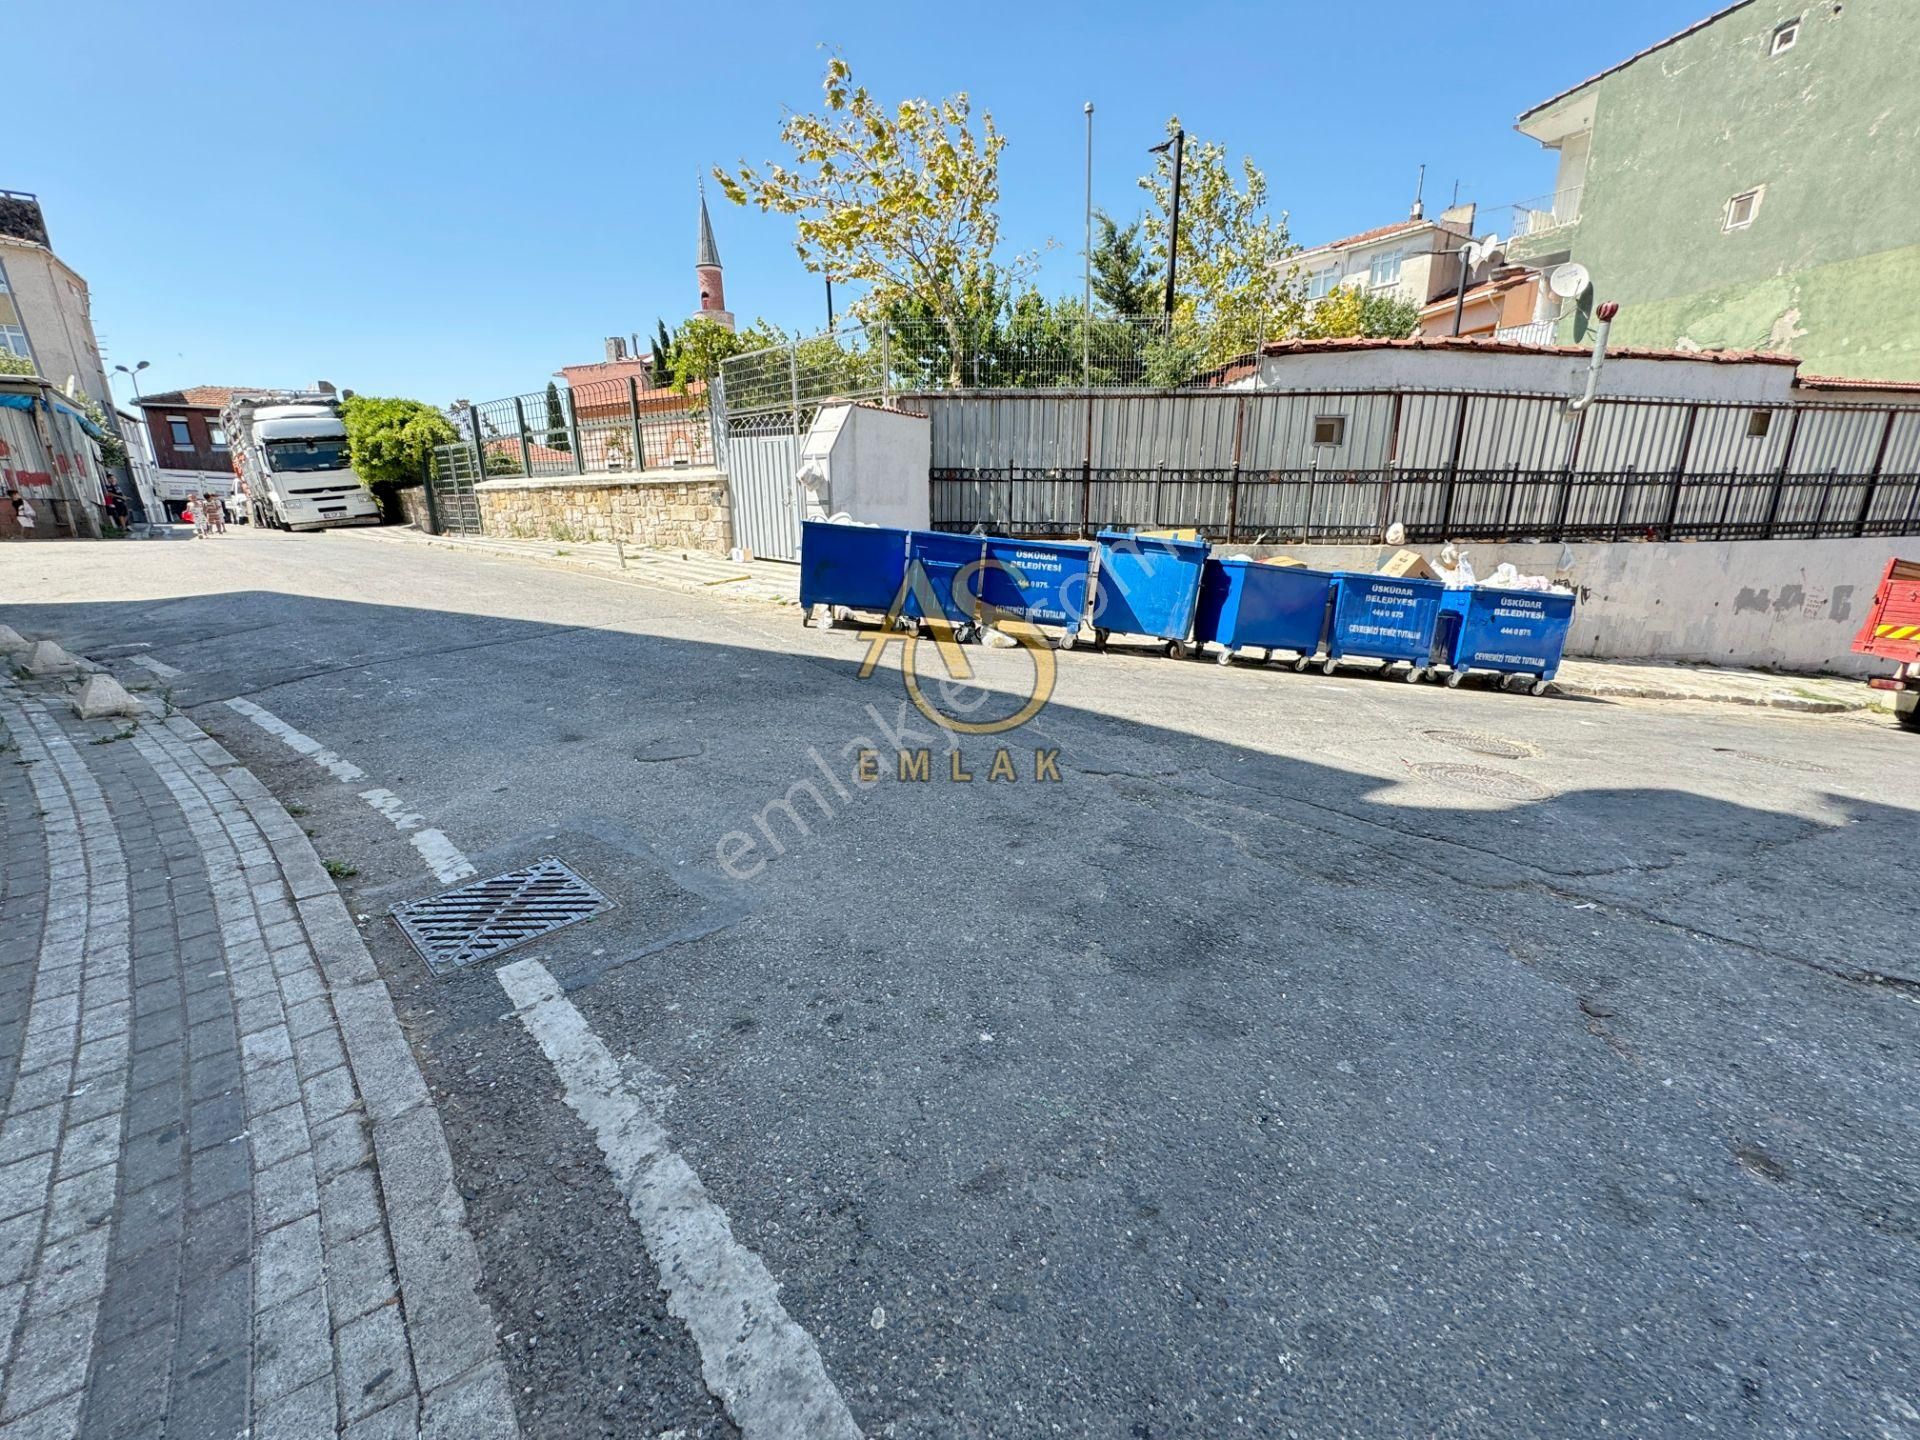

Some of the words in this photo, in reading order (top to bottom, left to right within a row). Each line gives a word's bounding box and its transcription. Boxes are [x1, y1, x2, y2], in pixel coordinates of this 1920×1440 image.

[1372, 584, 1413, 596] ÜSKÜDAR
[1366, 594, 1417, 607] BELEDİYESİ
[1501, 597, 1542, 609] ÜSKÜDAR
[1494, 608, 1545, 620] BELEDİYESİ
